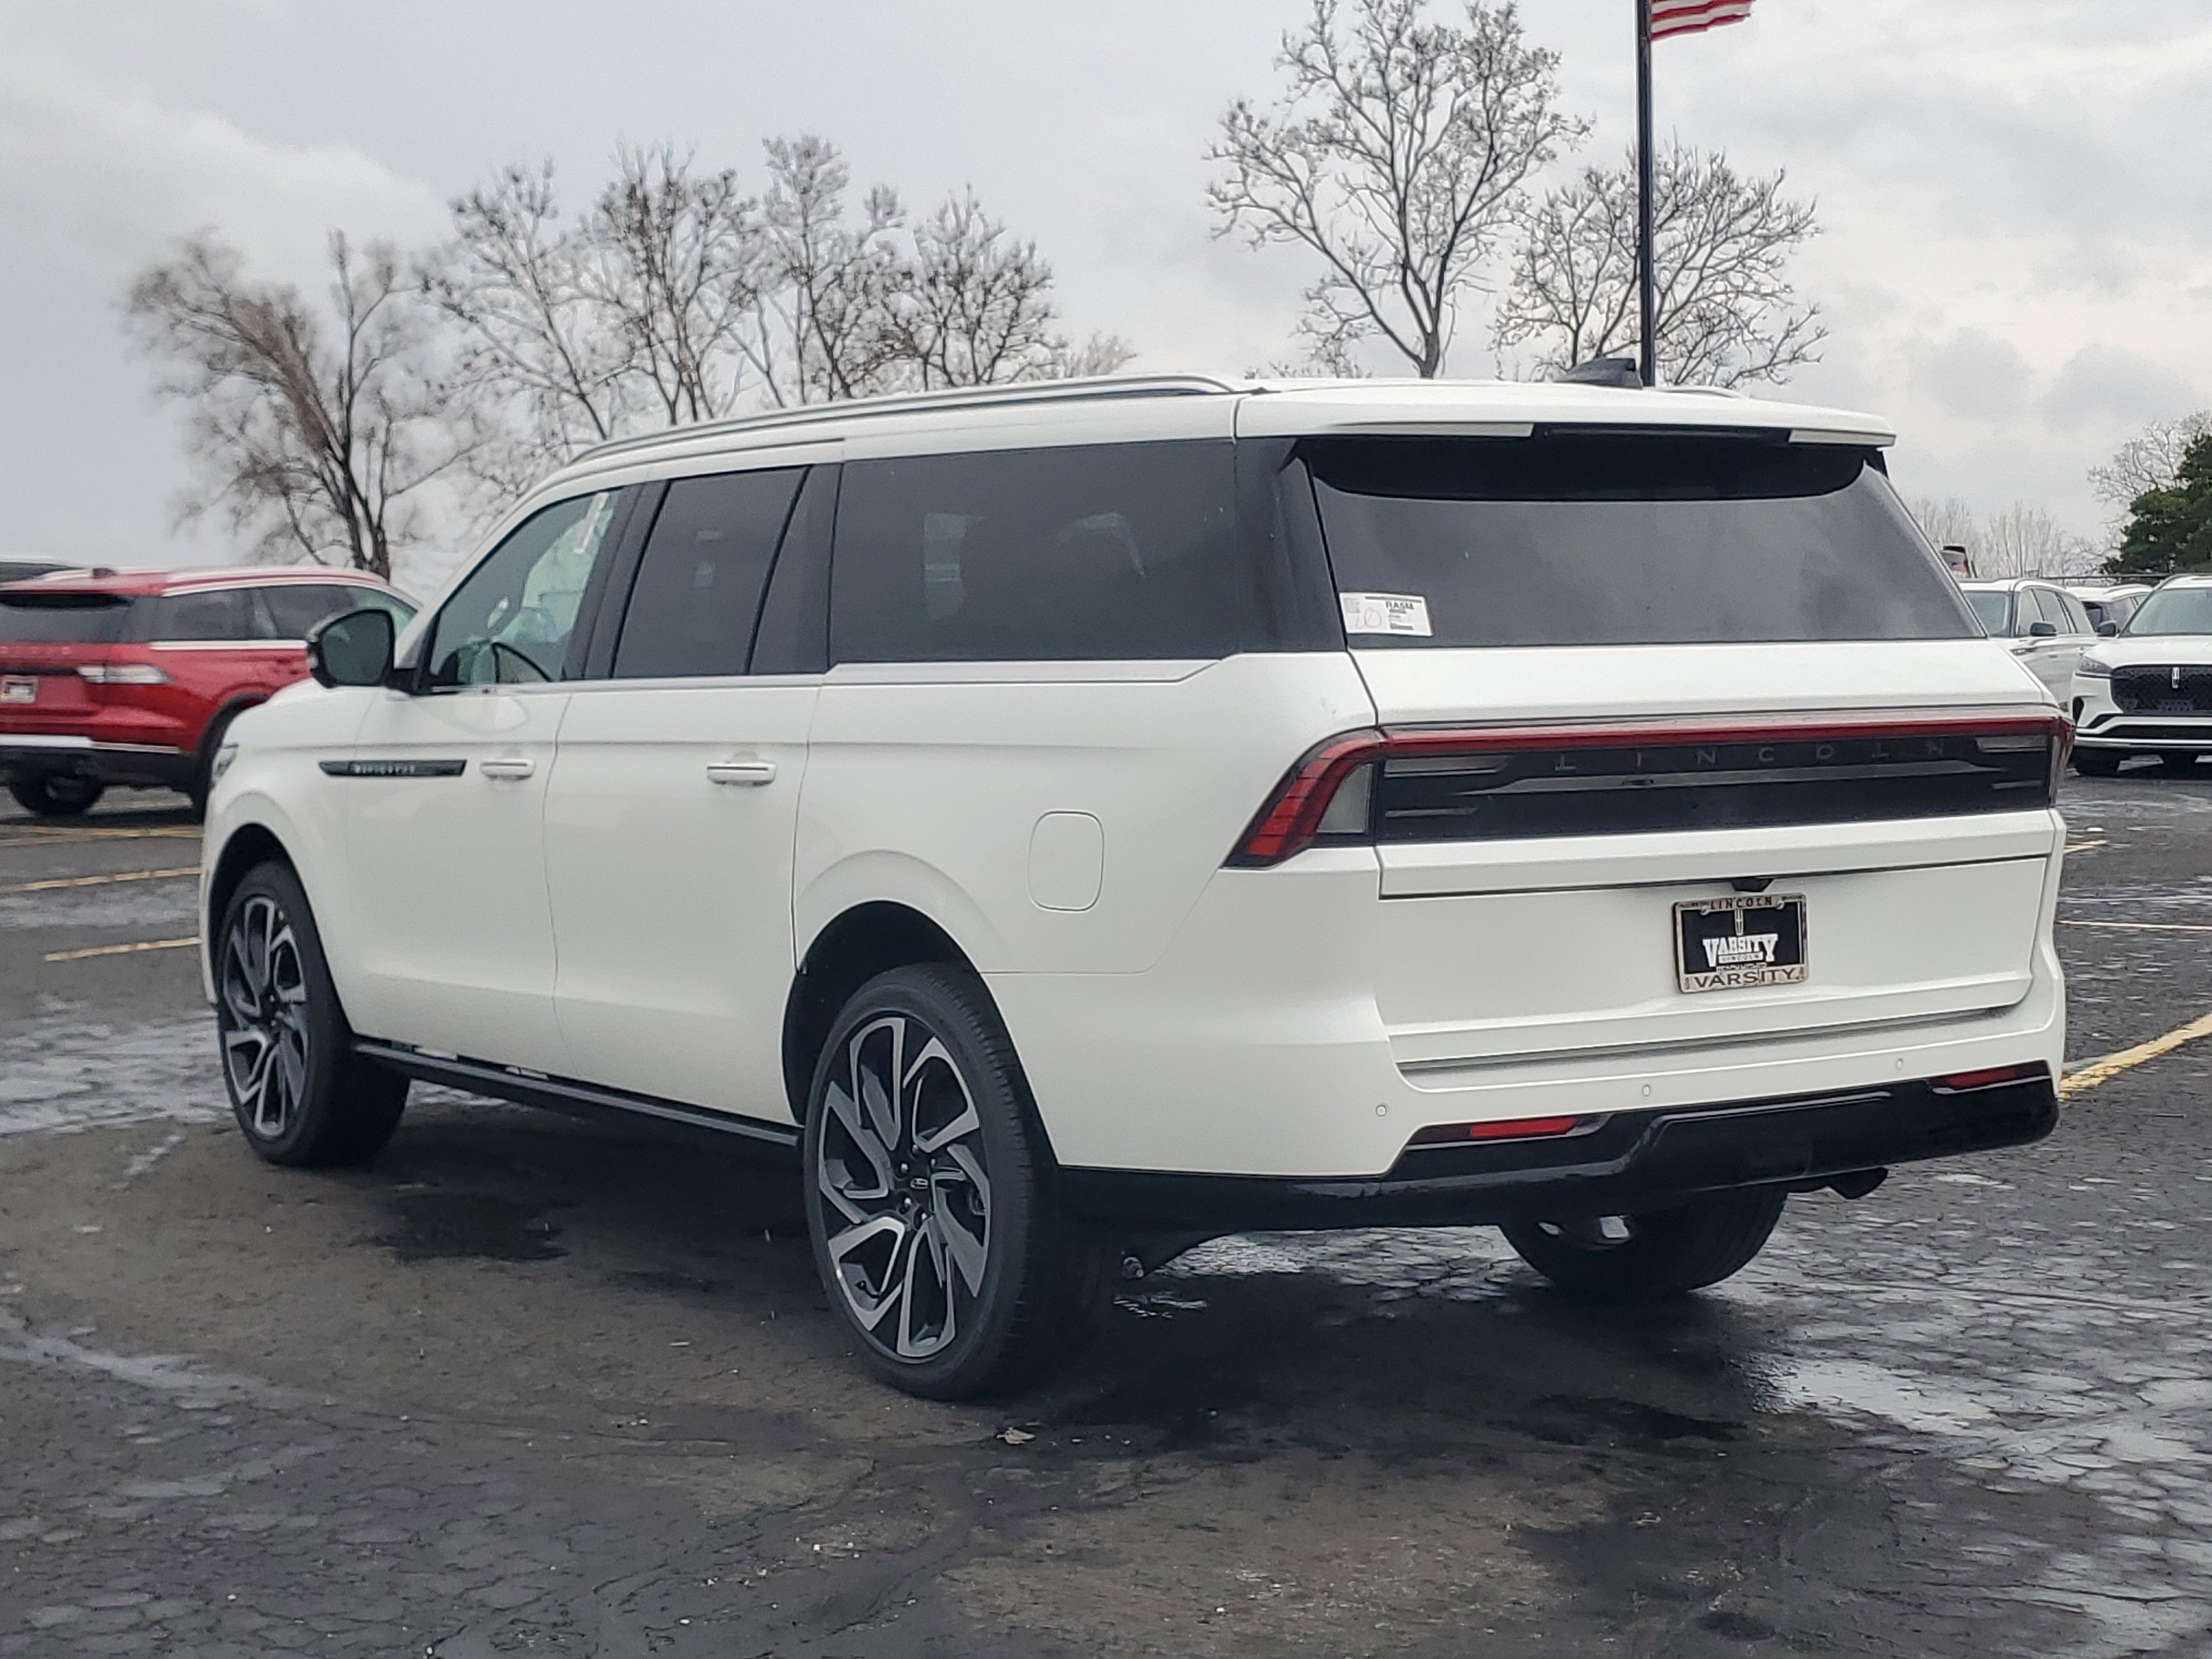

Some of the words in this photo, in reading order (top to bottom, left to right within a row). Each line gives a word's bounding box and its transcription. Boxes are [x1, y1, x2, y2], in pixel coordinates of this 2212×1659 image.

[1555, 741, 1944, 771] LINCOLN
[1710, 896, 1773, 910] LINCOLN
[1702, 934, 1778, 967] VARSITY
[1694, 968, 1796, 988] VARSITY
